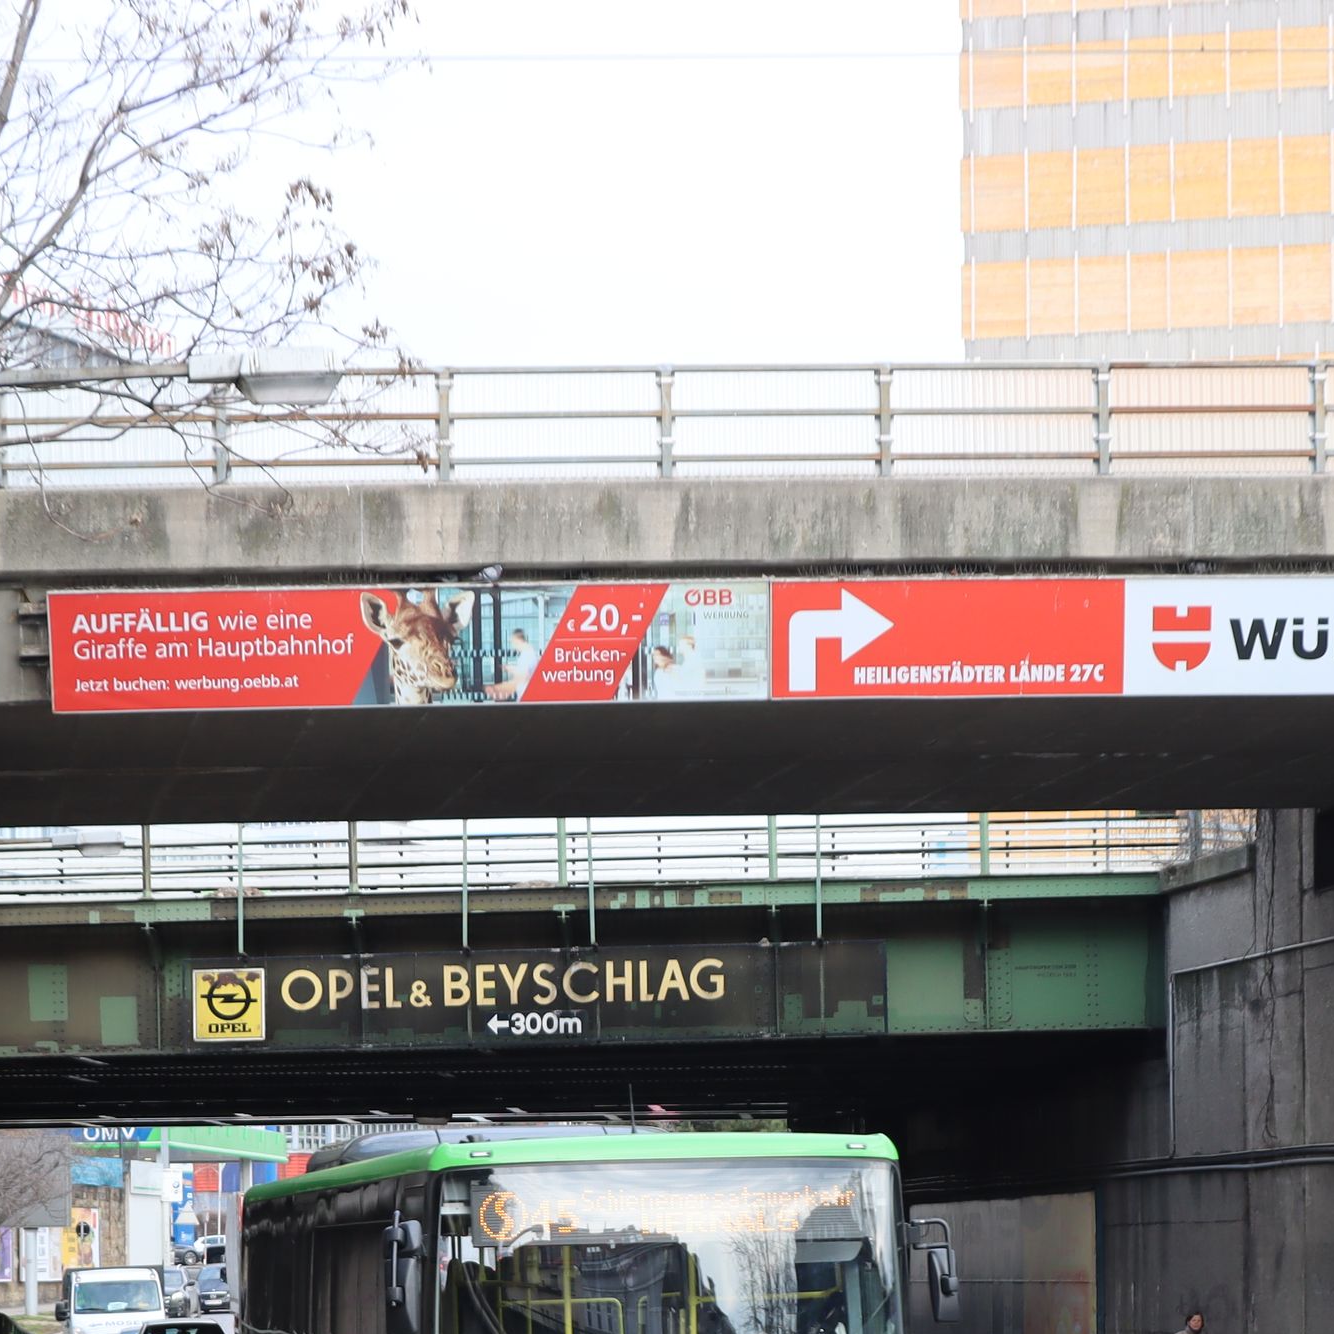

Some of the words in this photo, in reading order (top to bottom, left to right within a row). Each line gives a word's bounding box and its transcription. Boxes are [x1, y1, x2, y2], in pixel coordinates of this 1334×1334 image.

[684, 588, 733, 606] ÖBB
[72, 608, 208, 634] AUFFÄLLIG
[217, 610, 257, 632] wie
[266, 609, 312, 631] eine
[703, 610, 749, 620] WERBUNG
[567, 619, 575, 632] €
[73, 637, 147, 660] Giraffe
[155, 641, 189, 659] am
[197, 633, 354, 661] Hauptbahnhof
[555, 647, 627, 663] Brücken-
[542, 667, 614, 685] werbung
[853, 661, 1005, 684] HEILIGENSTÄDTER
[1010, 660, 1065, 683] LÄNDE
[1070, 663, 1105, 683] 27C
[74, 678, 108, 692] Jetzt
[113, 677, 170, 691] buchen:
[175, 675, 299, 692] werbung.oebb.at
[281, 967, 402, 1011] OPEL
[410, 980, 432, 1007] &
[443, 958, 725, 1006] BEYSCHLAG
[208, 1023, 251, 1033] OPEL
[511, 1012, 582, 1035] 300m
[83, 1127, 135, 1141] OMV
[640, 1206, 800, 1234] HERNALS
